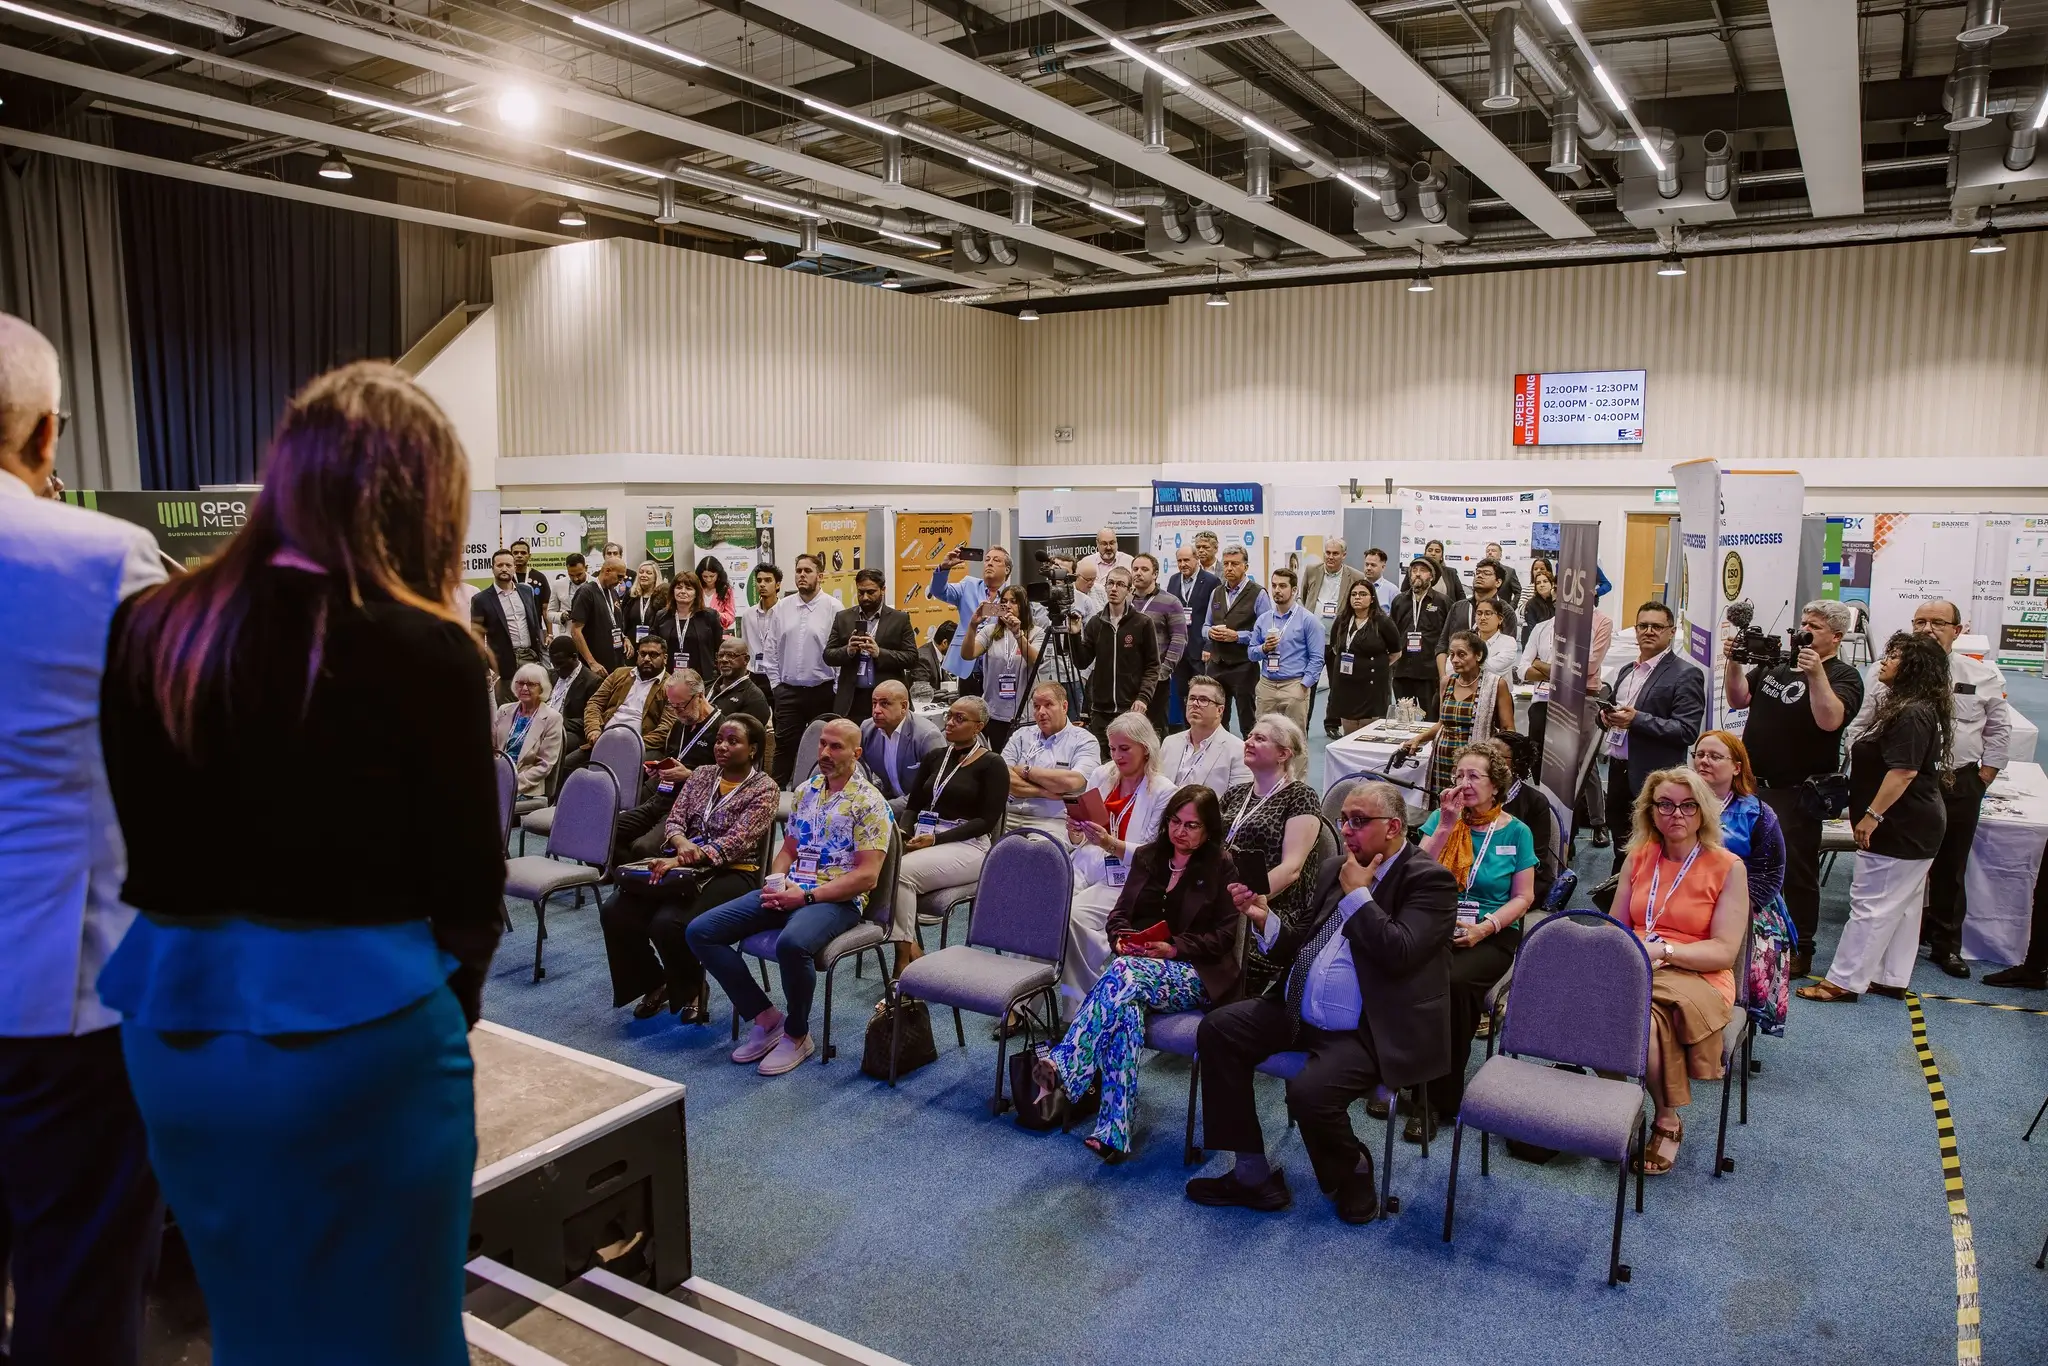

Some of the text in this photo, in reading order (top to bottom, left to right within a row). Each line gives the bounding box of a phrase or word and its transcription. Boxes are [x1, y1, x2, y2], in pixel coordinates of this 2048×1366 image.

[1545, 385, 1588, 395] 12:00PM
[1596, 383, 1639, 393] 12:30PM
[1543, 400, 1587, 409] 02.00PM
[1595, 398, 1640, 407] 02.30PM
[1515, 393, 1525, 427] SPEED
[1525, 375, 1536, 445] NETWORKING
[1542, 414, 1585, 423] 03:30PM
[1594, 412, 1640, 421] 04:00PM
[1179, 488, 1218, 503] NETWORK
[1223, 488, 1253, 503] GROW
[200, 501, 246, 514] QPQ
[1173, 504, 1201, 512] BUSINESS
[1202, 504, 1255, 512] CONNECTORS
[1207, 518, 1232, 526] Business
[1232, 517, 1255, 526] Growth
[1739, 533, 1783, 546] PROCESSES
[1727, 568, 1738, 579] ISO
[1762, 674, 1785, 691] Alliance
[1761, 683, 1780, 699] Media
[1724, 720, 1743, 730] PROCESS
